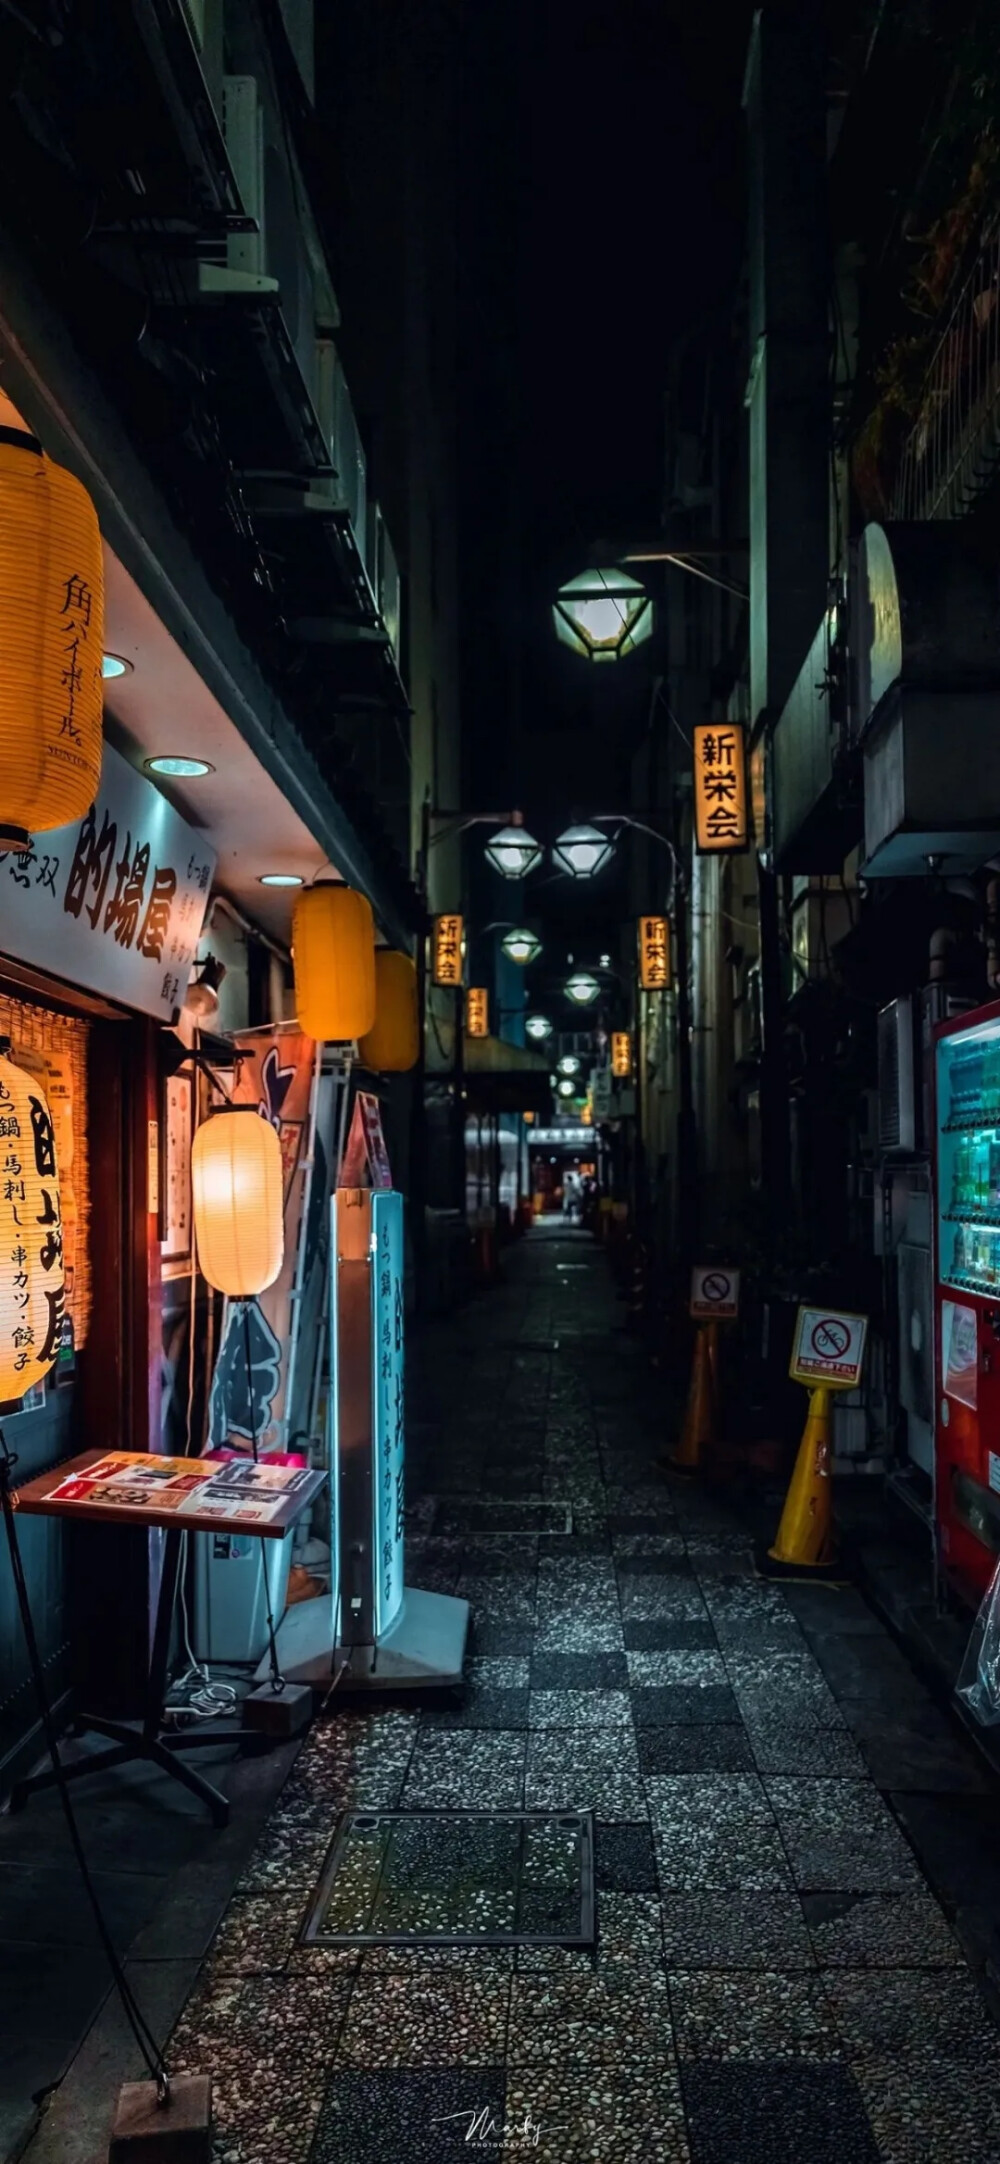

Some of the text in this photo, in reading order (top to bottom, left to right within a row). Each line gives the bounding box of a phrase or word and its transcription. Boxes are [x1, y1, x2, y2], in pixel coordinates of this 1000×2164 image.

[61, 573, 91, 747] 角ハイボール。
[702, 733, 740, 839] 新栄会
[0, 838, 60, 898] 無双
[64, 803, 176, 963] 的場屋
[438, 919, 458, 979] 新栄会
[646, 920, 668, 983] 新栄会
